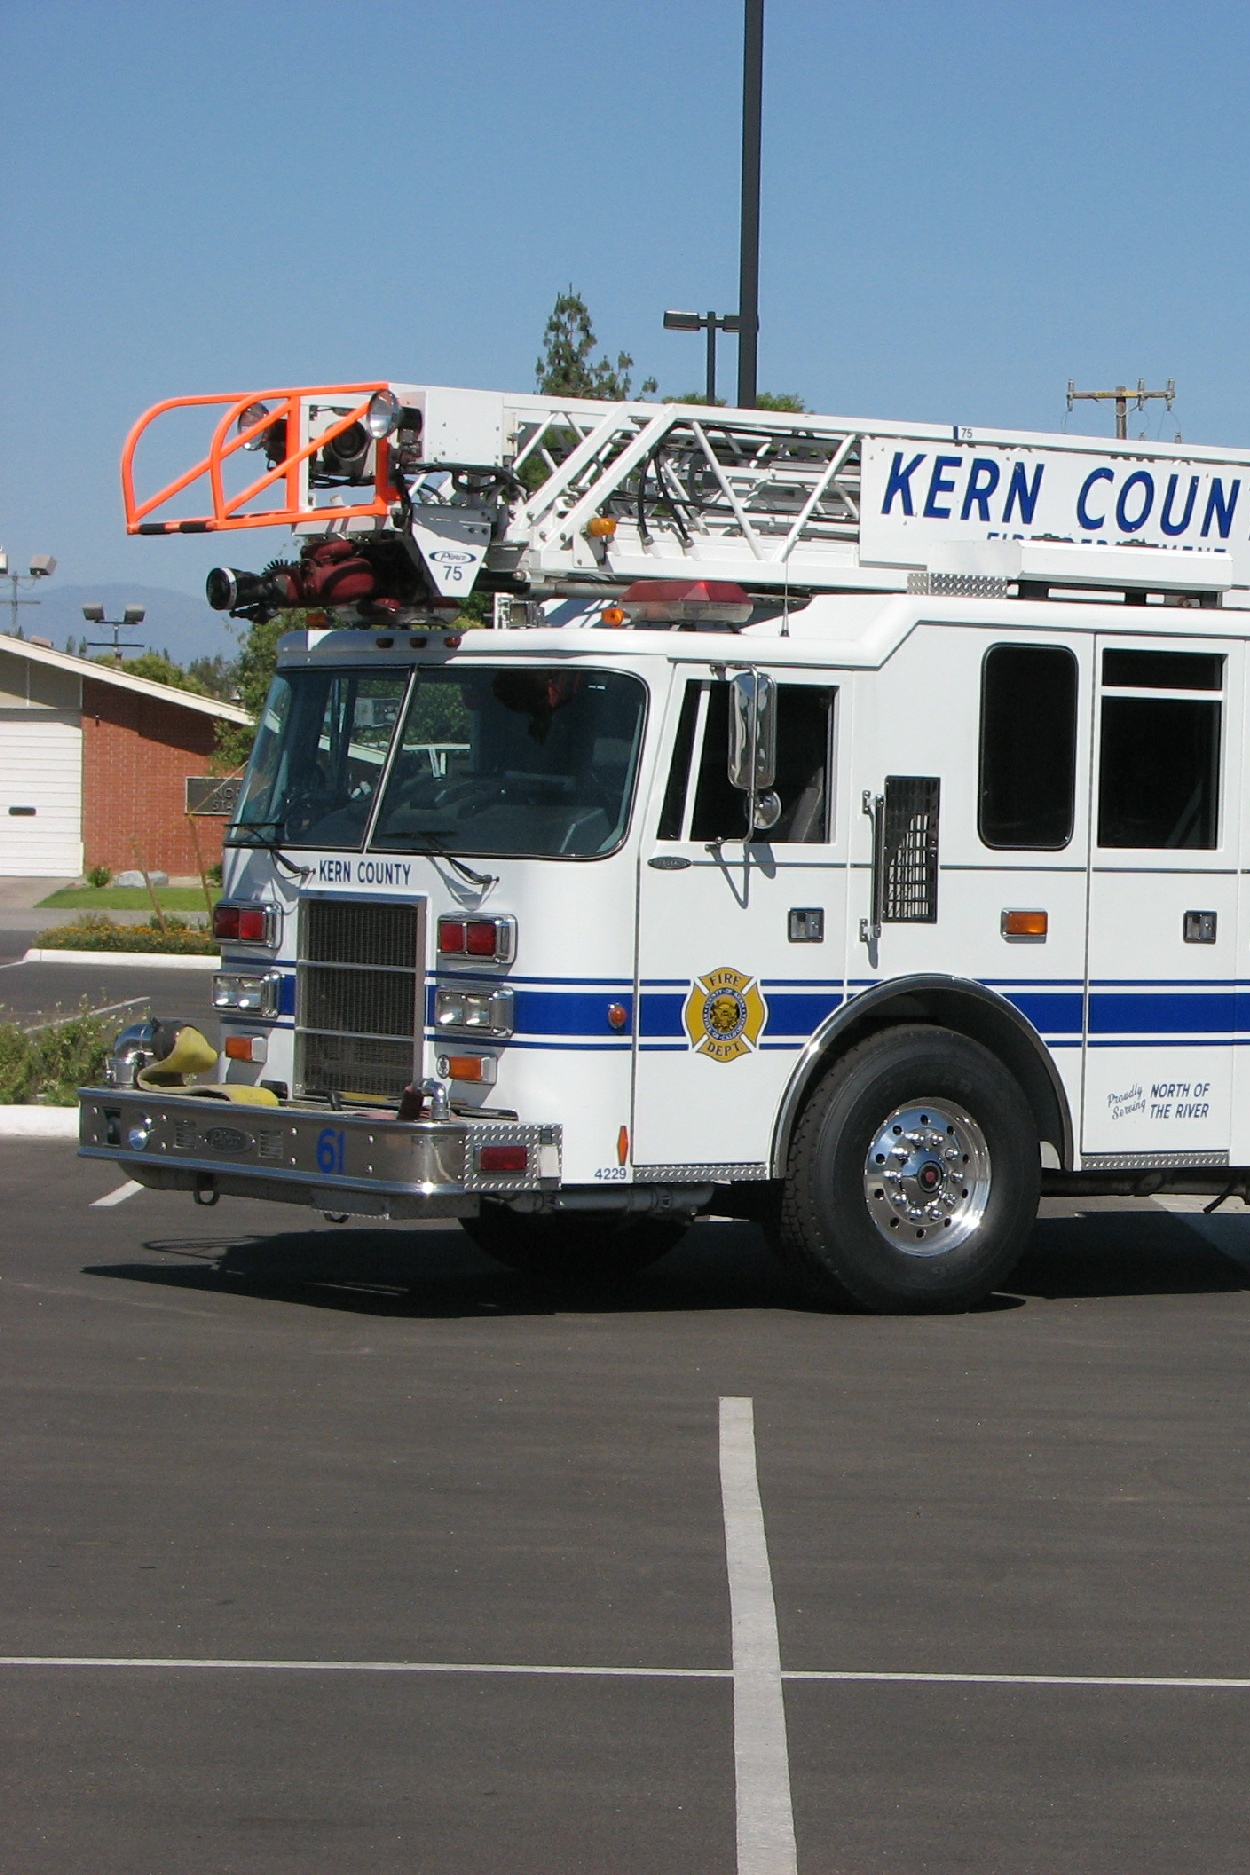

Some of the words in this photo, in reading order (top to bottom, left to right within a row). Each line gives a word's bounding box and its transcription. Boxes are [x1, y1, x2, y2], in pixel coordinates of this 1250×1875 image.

[961, 427, 973, 439] 75
[881, 452, 1045, 524] KERN
[443, 565, 463, 582] 75
[319, 860, 351, 883] KERN
[357, 861, 411, 885] COUNTY
[709, 973, 741, 987] FIRE
[1107, 1083, 1143, 1108] Proudly
[1150, 1083, 1191, 1098] NORTH
[1193, 1083, 1211, 1098] OF
[1111, 1098, 1146, 1120] Serving
[1150, 1103, 1172, 1119] THE
[1175, 1103, 1210, 1119] RIVER
[316, 1126, 347, 1175] 61
[594, 1167, 627, 1180] 4229
